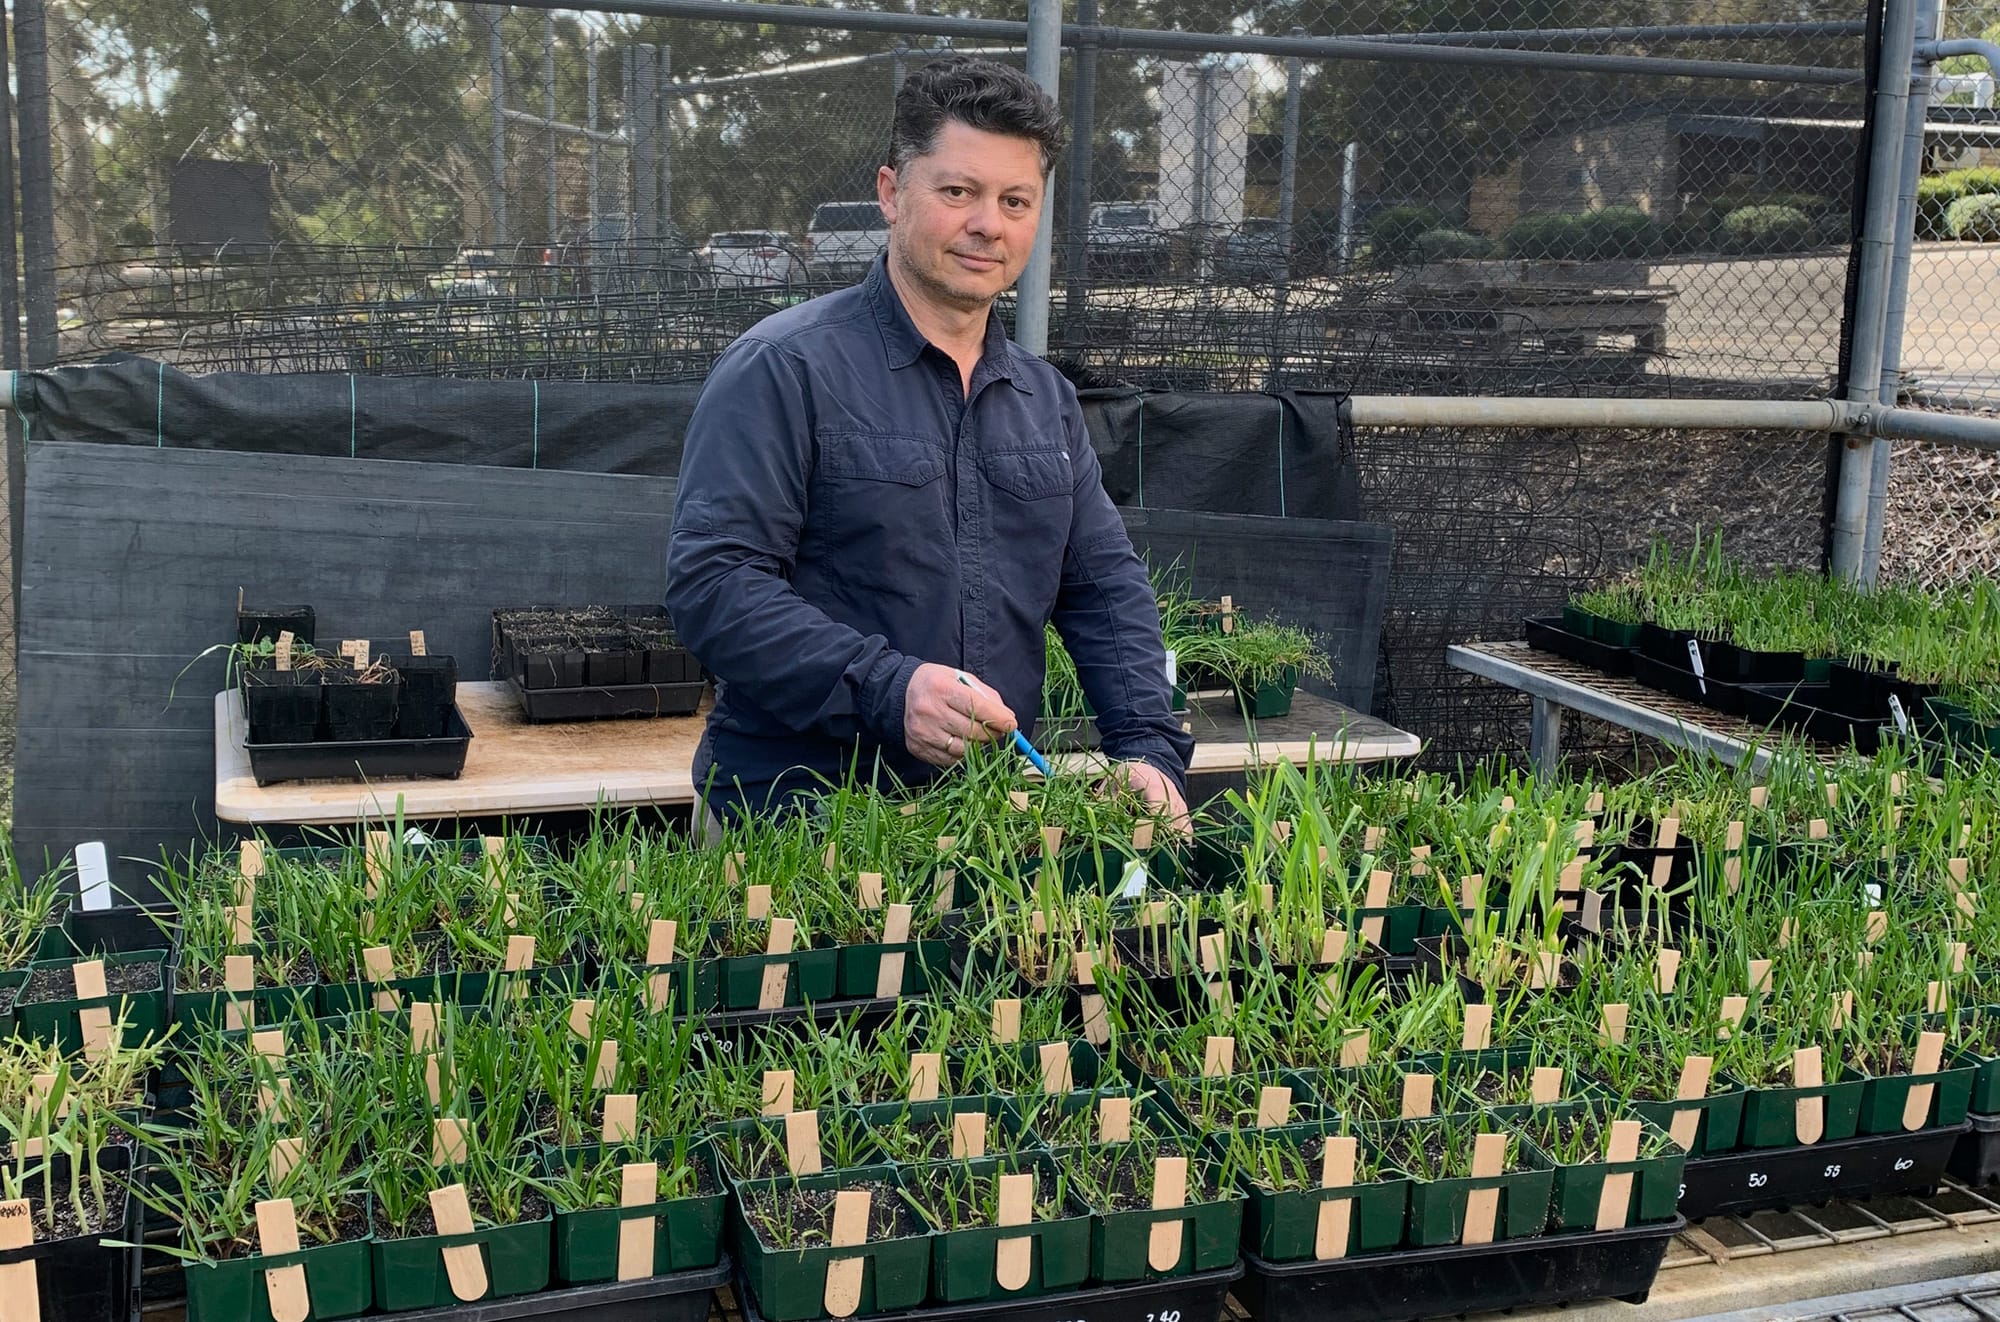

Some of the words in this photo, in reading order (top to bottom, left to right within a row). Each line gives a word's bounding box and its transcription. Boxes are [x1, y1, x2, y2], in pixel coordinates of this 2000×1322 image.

[1748, 1172, 1768, 1188] 50
[1824, 1165, 1841, 1178] 55
[1894, 1158, 1914, 1171] 60
